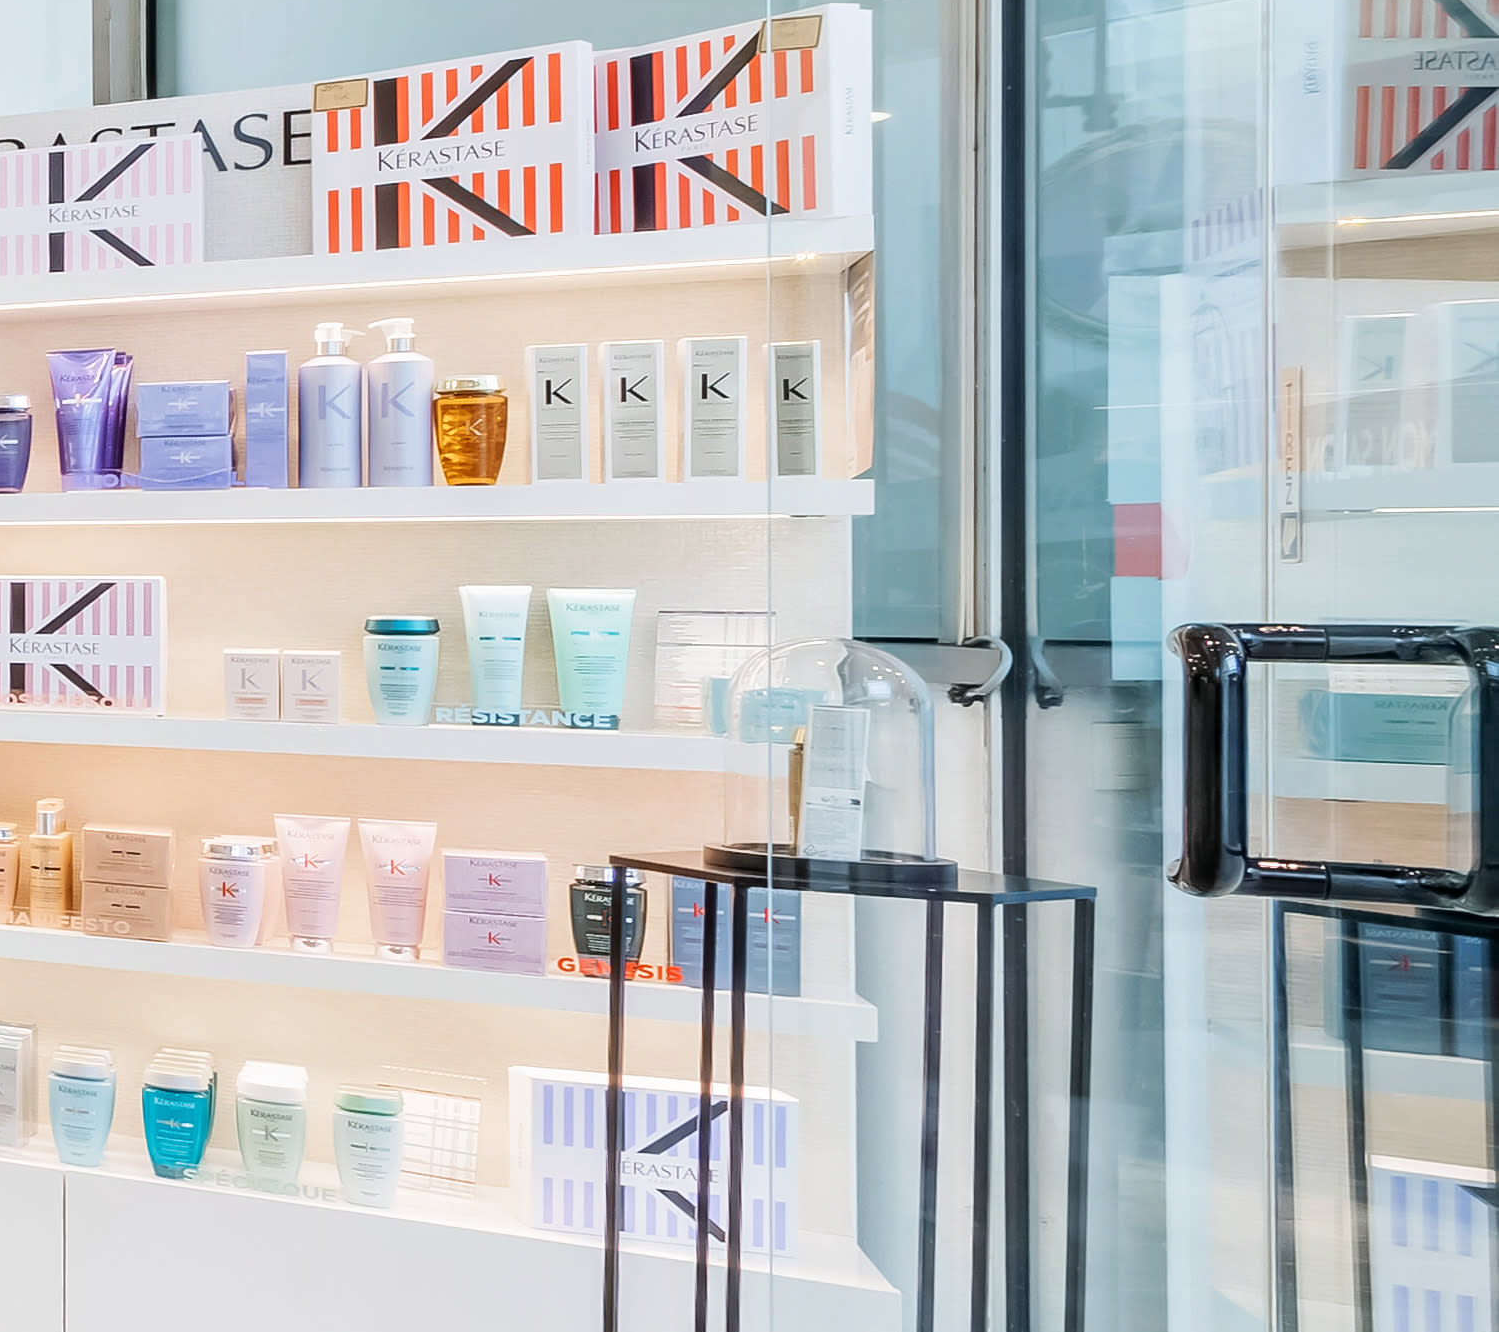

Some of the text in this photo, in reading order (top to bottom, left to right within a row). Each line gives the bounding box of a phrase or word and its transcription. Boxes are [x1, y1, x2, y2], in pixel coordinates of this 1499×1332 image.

[634, 114, 759, 154] KÉRASTASE
[377, 139, 505, 172] KÉRASTASE
[49, 204, 140, 224] KÉRASTASE
[545, 377, 574, 405] K
[621, 375, 650, 403] K
[701, 372, 731, 401] K
[783, 377, 809, 402] K
[10, 636, 100, 656] KÉRASTASE
[436, 703, 611, 729] RÉSISTANCE
[621, 1158, 719, 1183] ÉRASTAE
